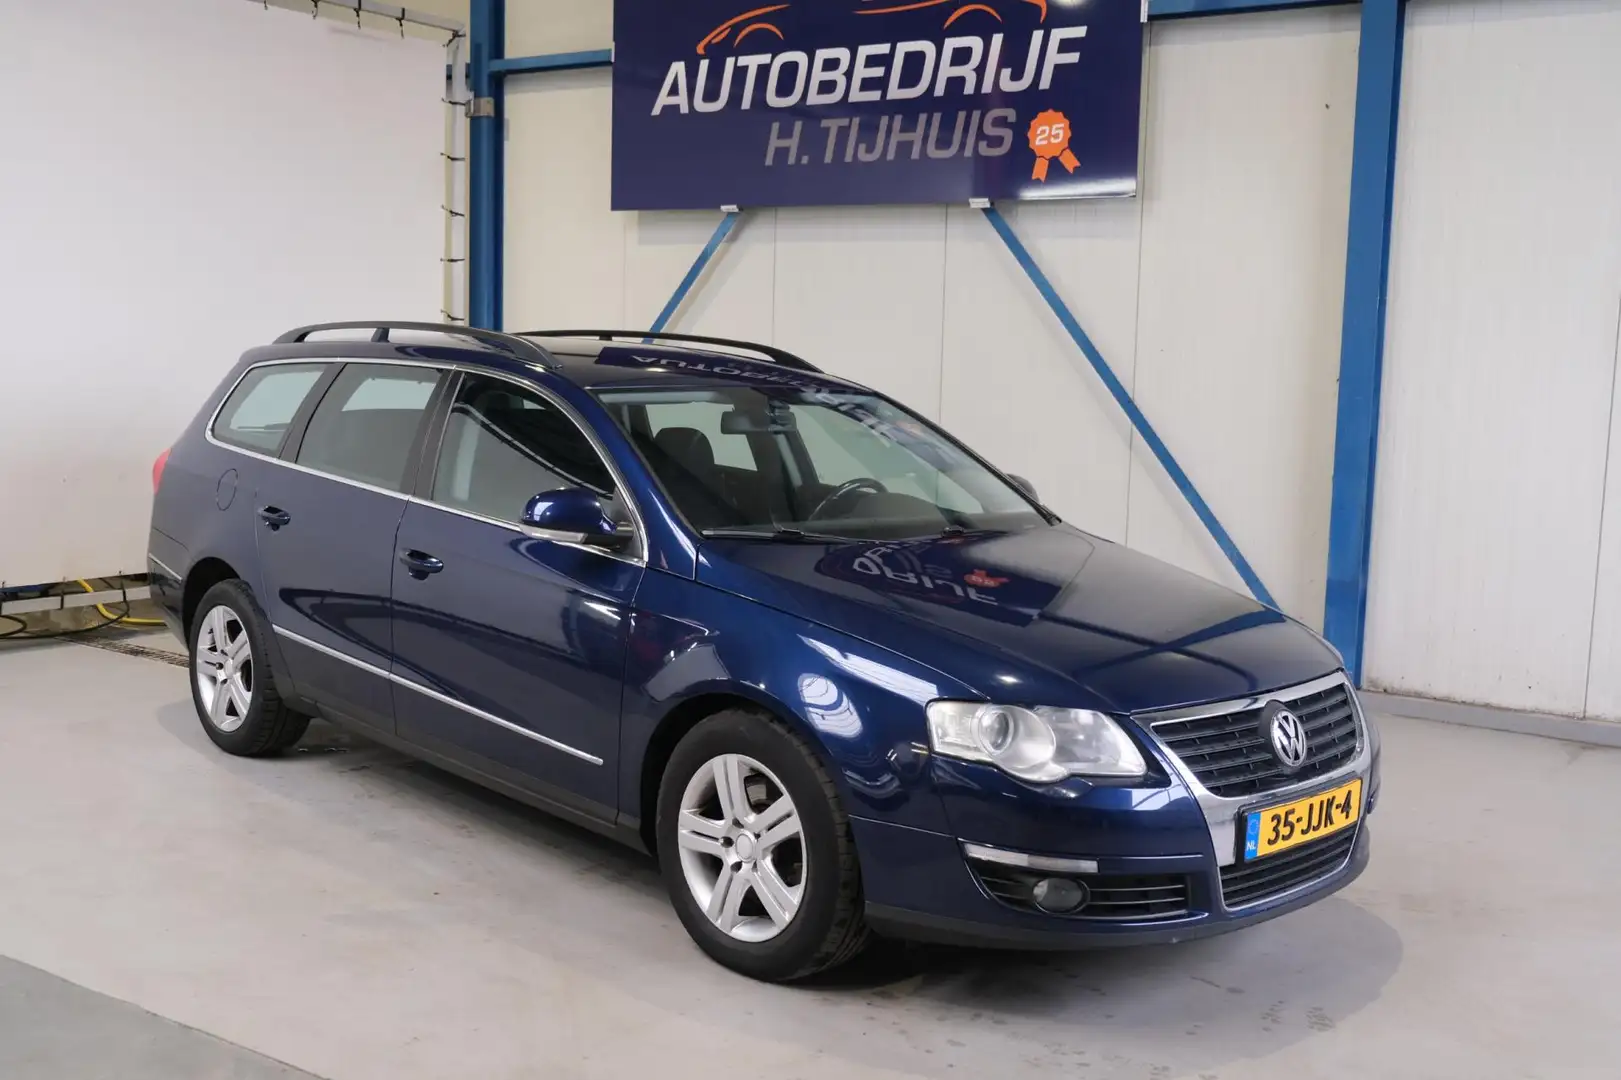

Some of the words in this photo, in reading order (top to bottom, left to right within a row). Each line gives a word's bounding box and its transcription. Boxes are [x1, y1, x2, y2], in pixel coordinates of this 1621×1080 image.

[650, 25, 1088, 116] AUTOBEDRIJF
[818, 107, 1017, 164] TIJHUIS
[1035, 123, 1065, 146] 25
[1246, 839, 1257, 851] NL
[1267, 789, 1353, 846] 35-JJK-4
